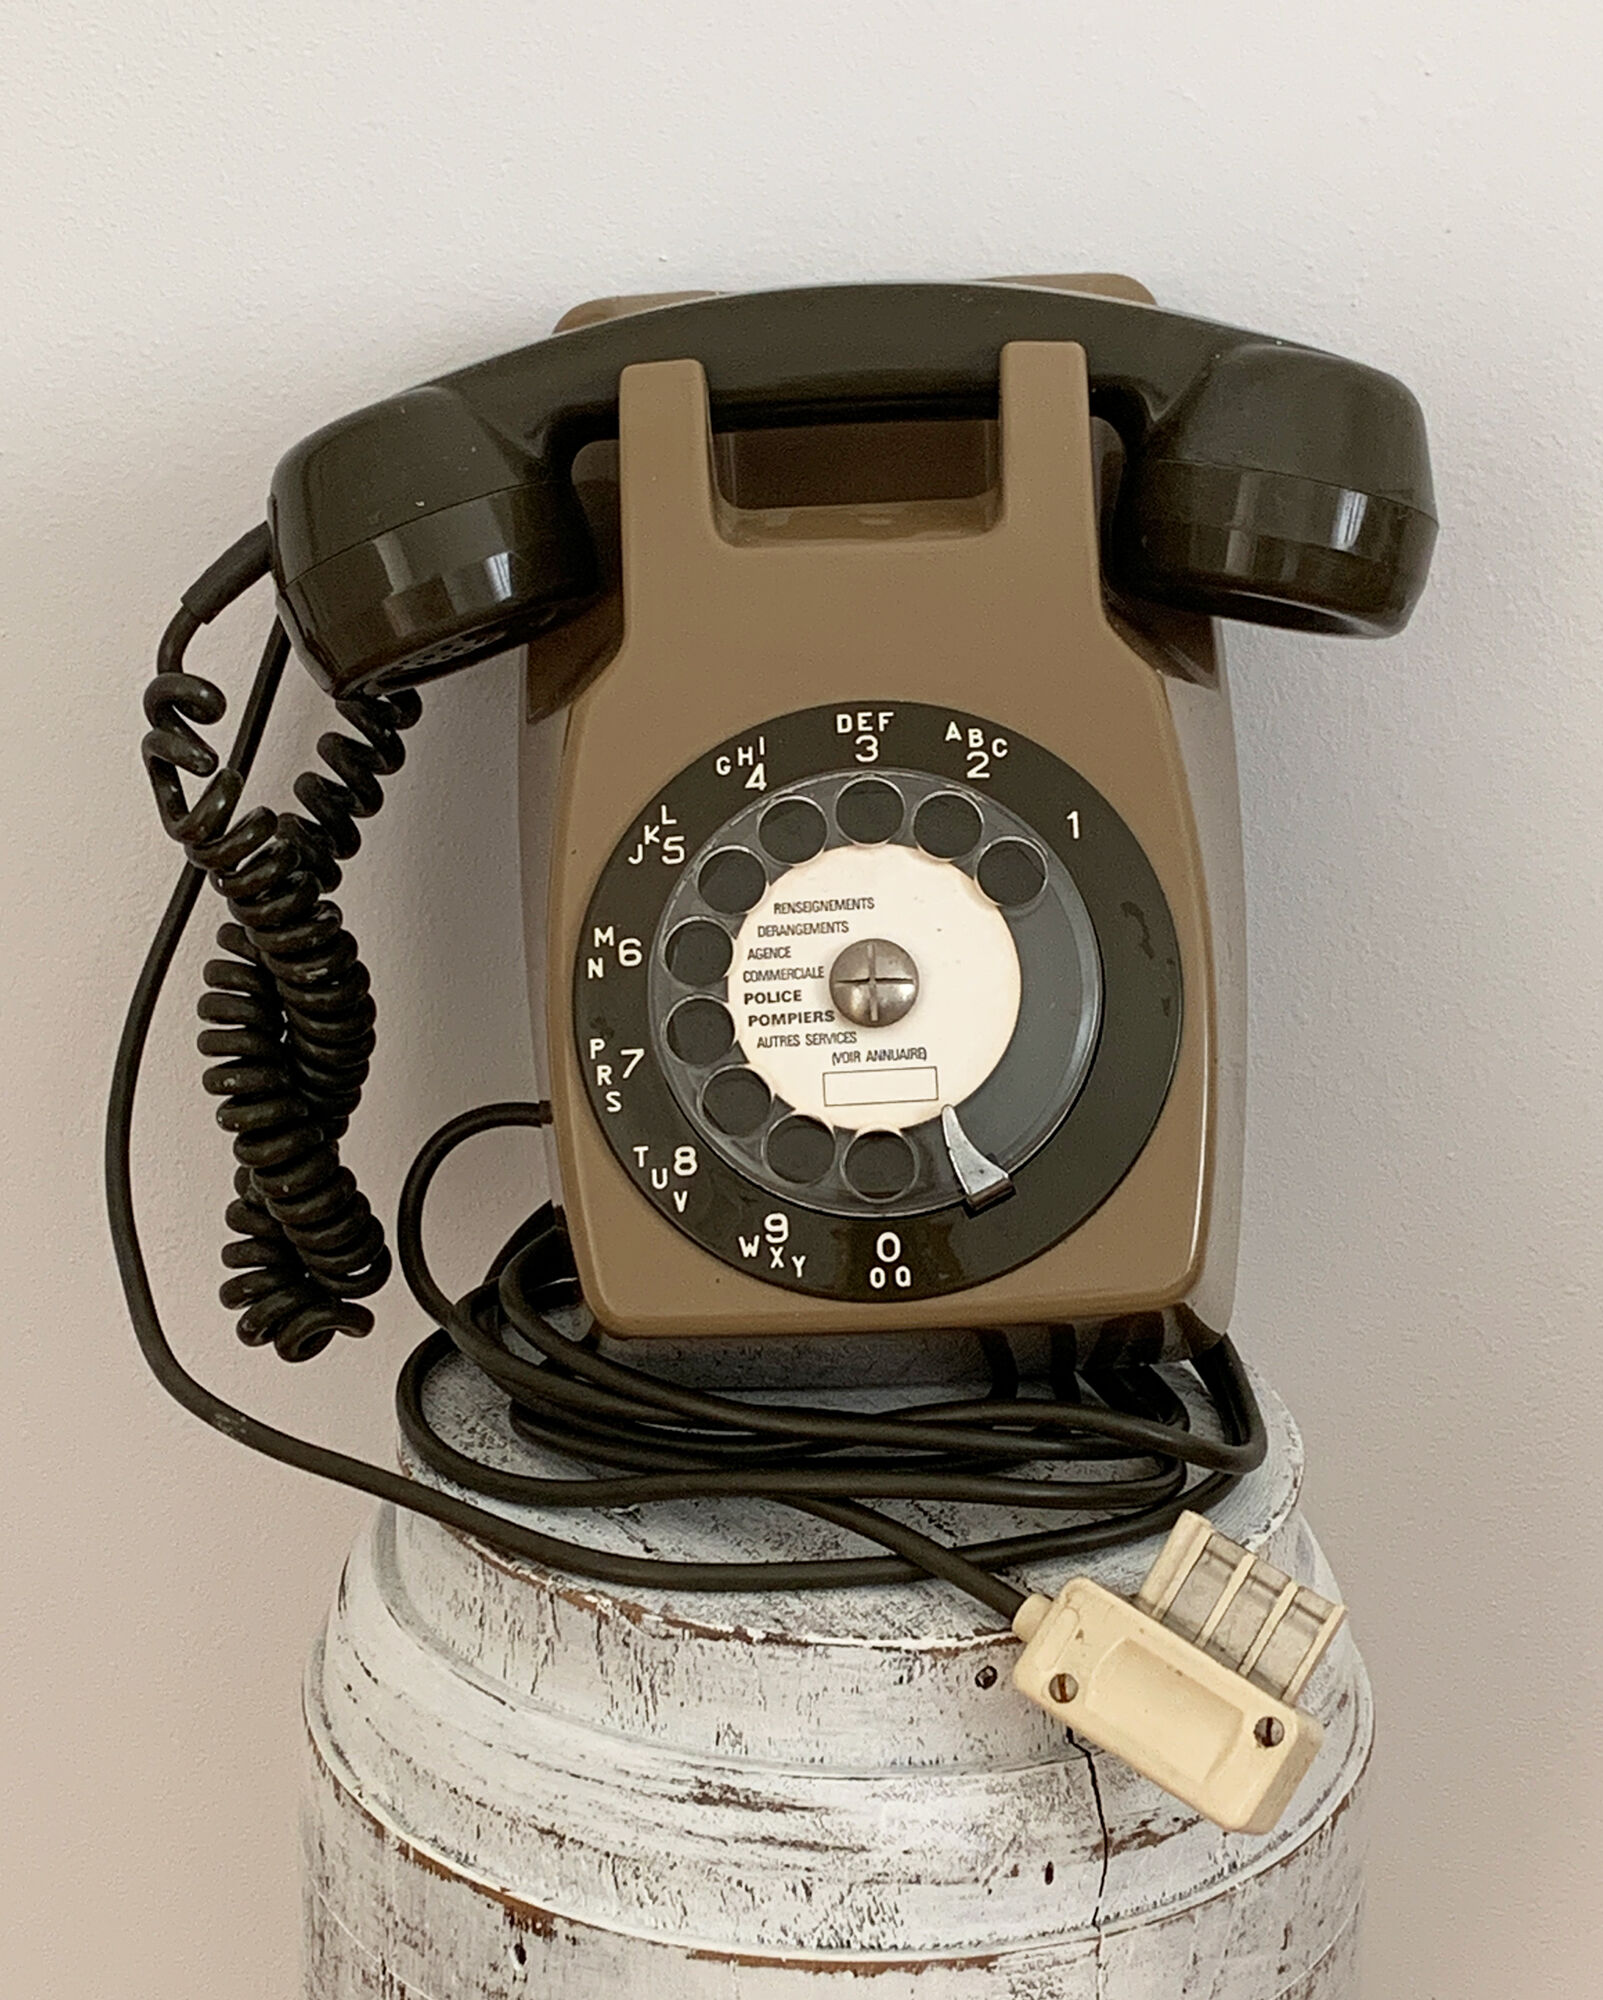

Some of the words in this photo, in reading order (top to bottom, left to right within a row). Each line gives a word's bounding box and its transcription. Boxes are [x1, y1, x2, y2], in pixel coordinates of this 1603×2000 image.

[837, 712, 893, 733] DEF
[856, 735, 878, 762] 3
[745, 762, 766, 790] 4
[967, 751, 989, 778] 2
[1067, 811, 1079, 838] 1
[662, 836, 684, 864] 5
[774, 897, 874, 914] RENSEIGNEMENTS
[758, 921, 849, 937] DERANGEMENTS
[619, 938, 642, 966] 6
[748, 946, 791, 960] AGENCE
[743, 966, 824, 983] COMMERCIALE
[744, 990, 801, 1005] POLICE
[748, 1010, 835, 1027] POMPIERS
[757, 1034, 800, 1048] AUTRES
[806, 1031, 857, 1046] SERVICES
[621, 1049, 644, 1078] 7
[832, 1051, 860, 1065] (VOIR
[866, 1047, 927, 1062] ANNUAIRE)
[674, 1146, 697, 1175] 8
[765, 1213, 788, 1243] 9
[877, 1232, 900, 1262] 0
